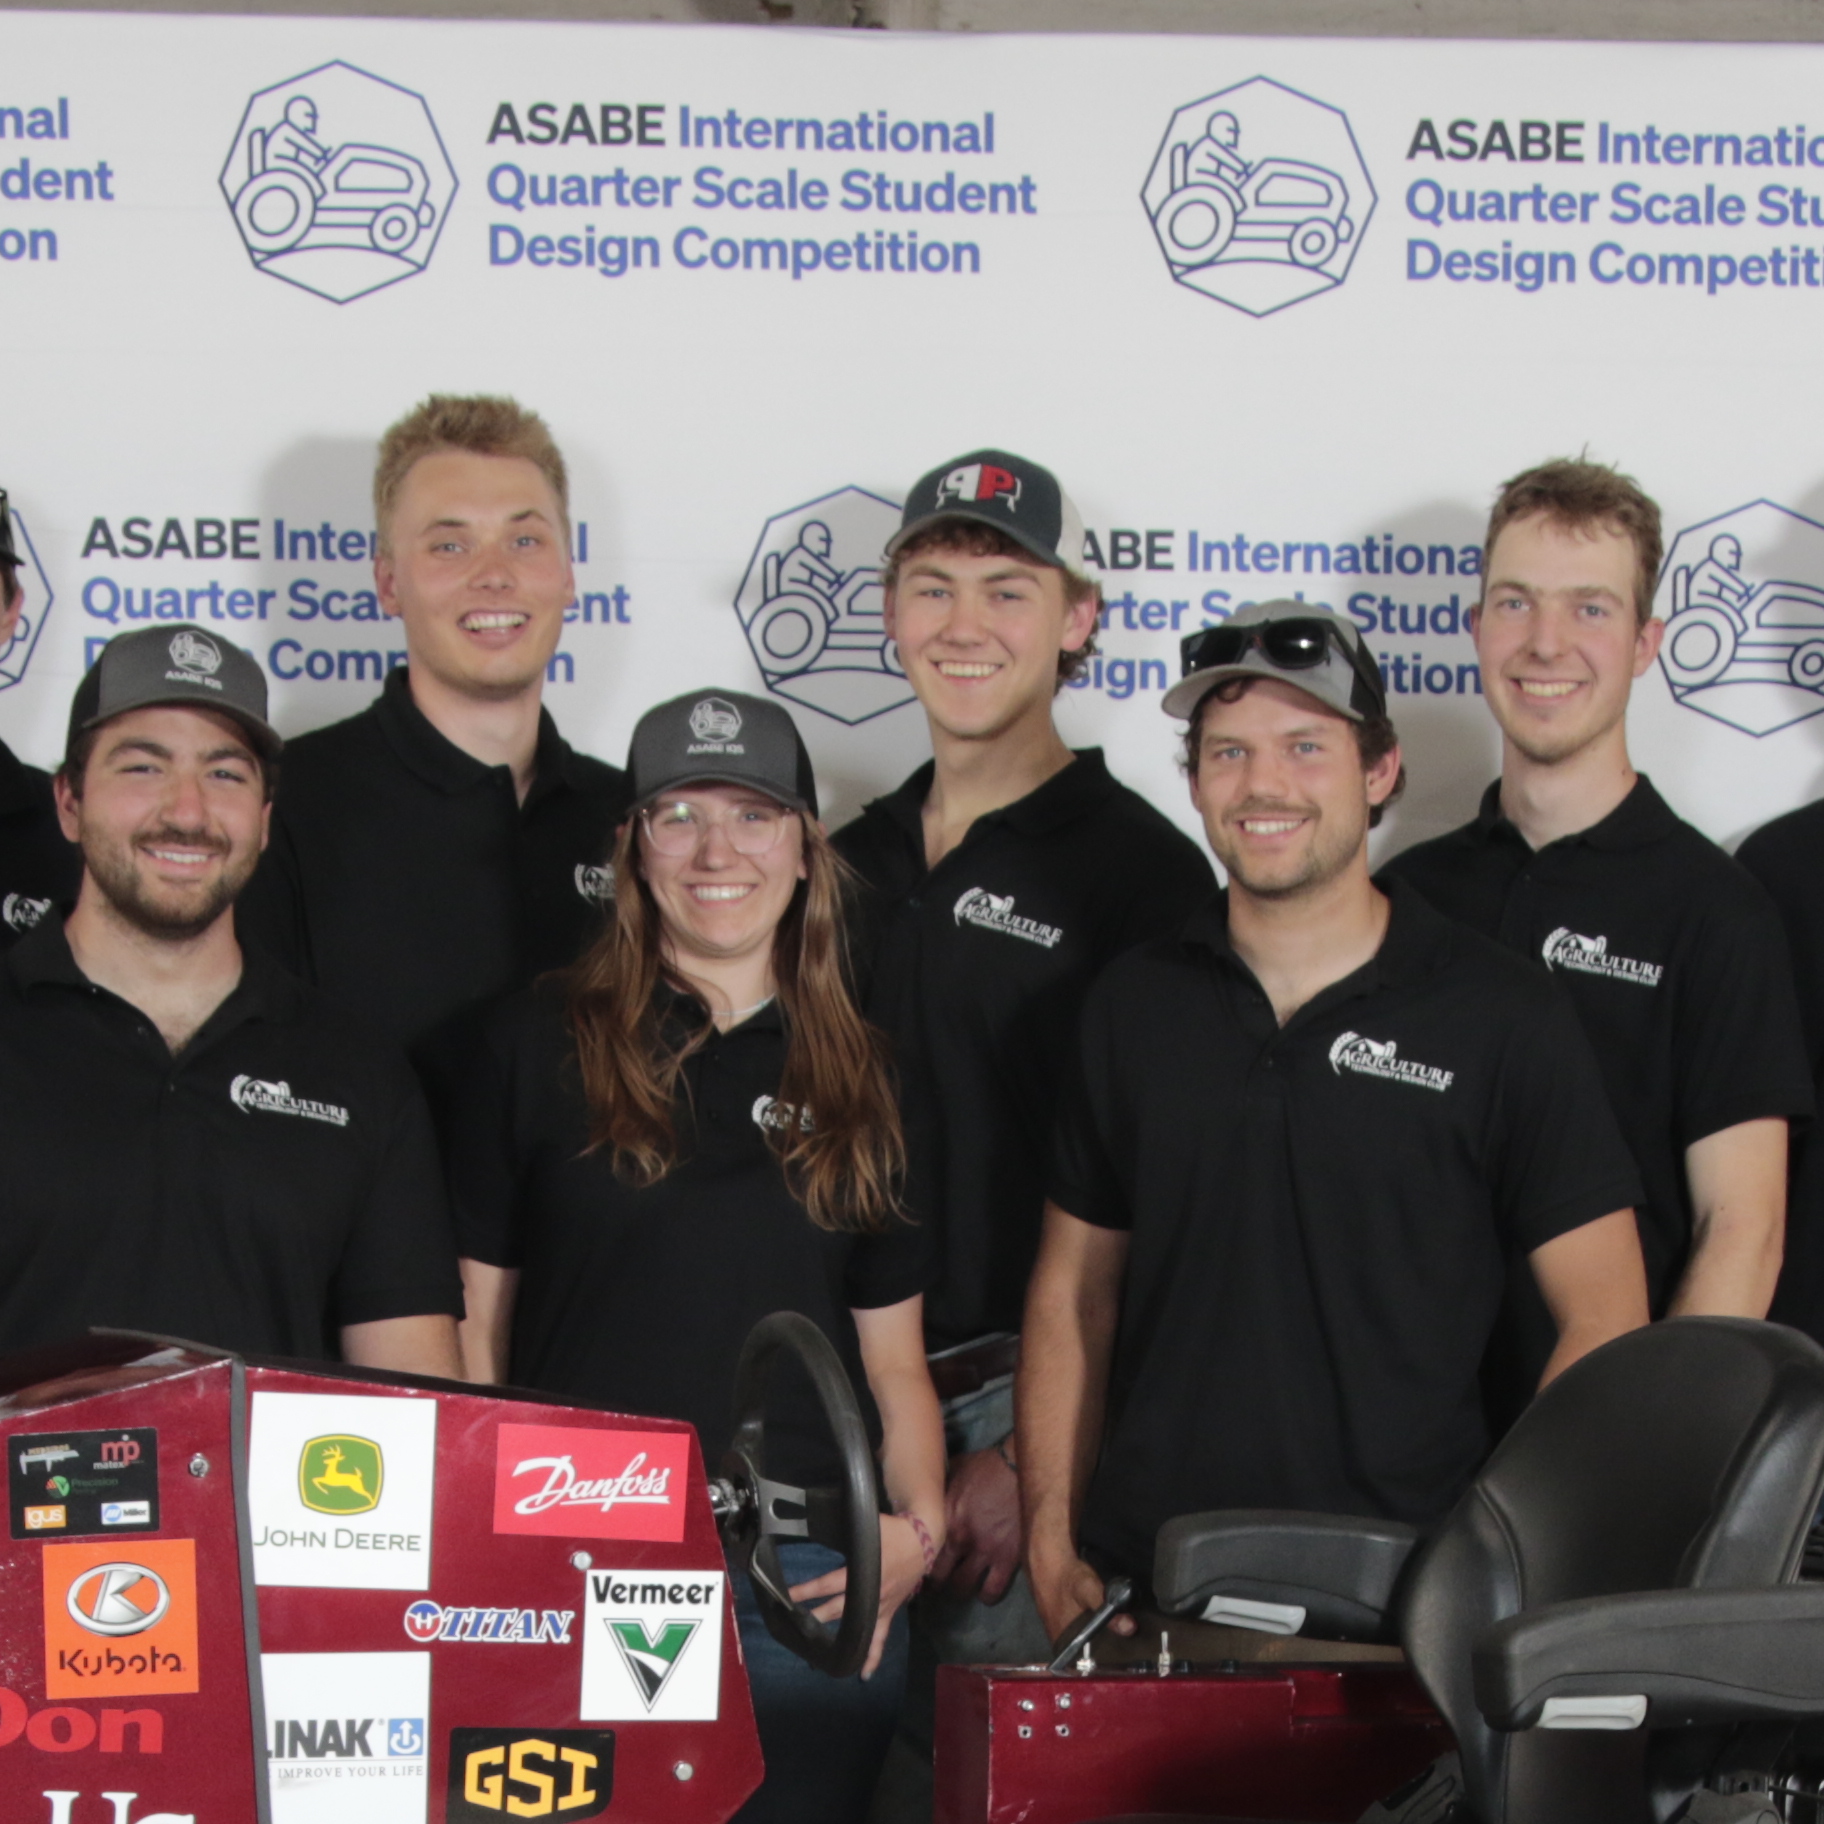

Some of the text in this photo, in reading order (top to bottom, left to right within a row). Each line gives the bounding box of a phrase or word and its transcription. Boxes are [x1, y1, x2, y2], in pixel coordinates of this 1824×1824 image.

[487, 102, 994, 153] ASABE International
[487, 163, 1036, 214] Quarter Scale Student
[490, 224, 979, 280] Design Competition
[1552, 945, 1663, 980] AGRICULTURE
[1336, 1048, 1454, 1086] AGRICULTURE
[240, 1090, 349, 1120] AGRICULTURE
[511, 1452, 672, 1513] Danfoss
[253, 1525, 421, 1551] JOHN DEERE
[592, 1575, 715, 1605] Vermeer
[439, 1606, 575, 1644] TITAN
[59, 1645, 182, 1677] Kubota
[267, 1718, 375, 1758] INAK
[278, 1765, 423, 1778] IMPROVE YOUR LIFE
[464, 1738, 598, 1818] GSI
